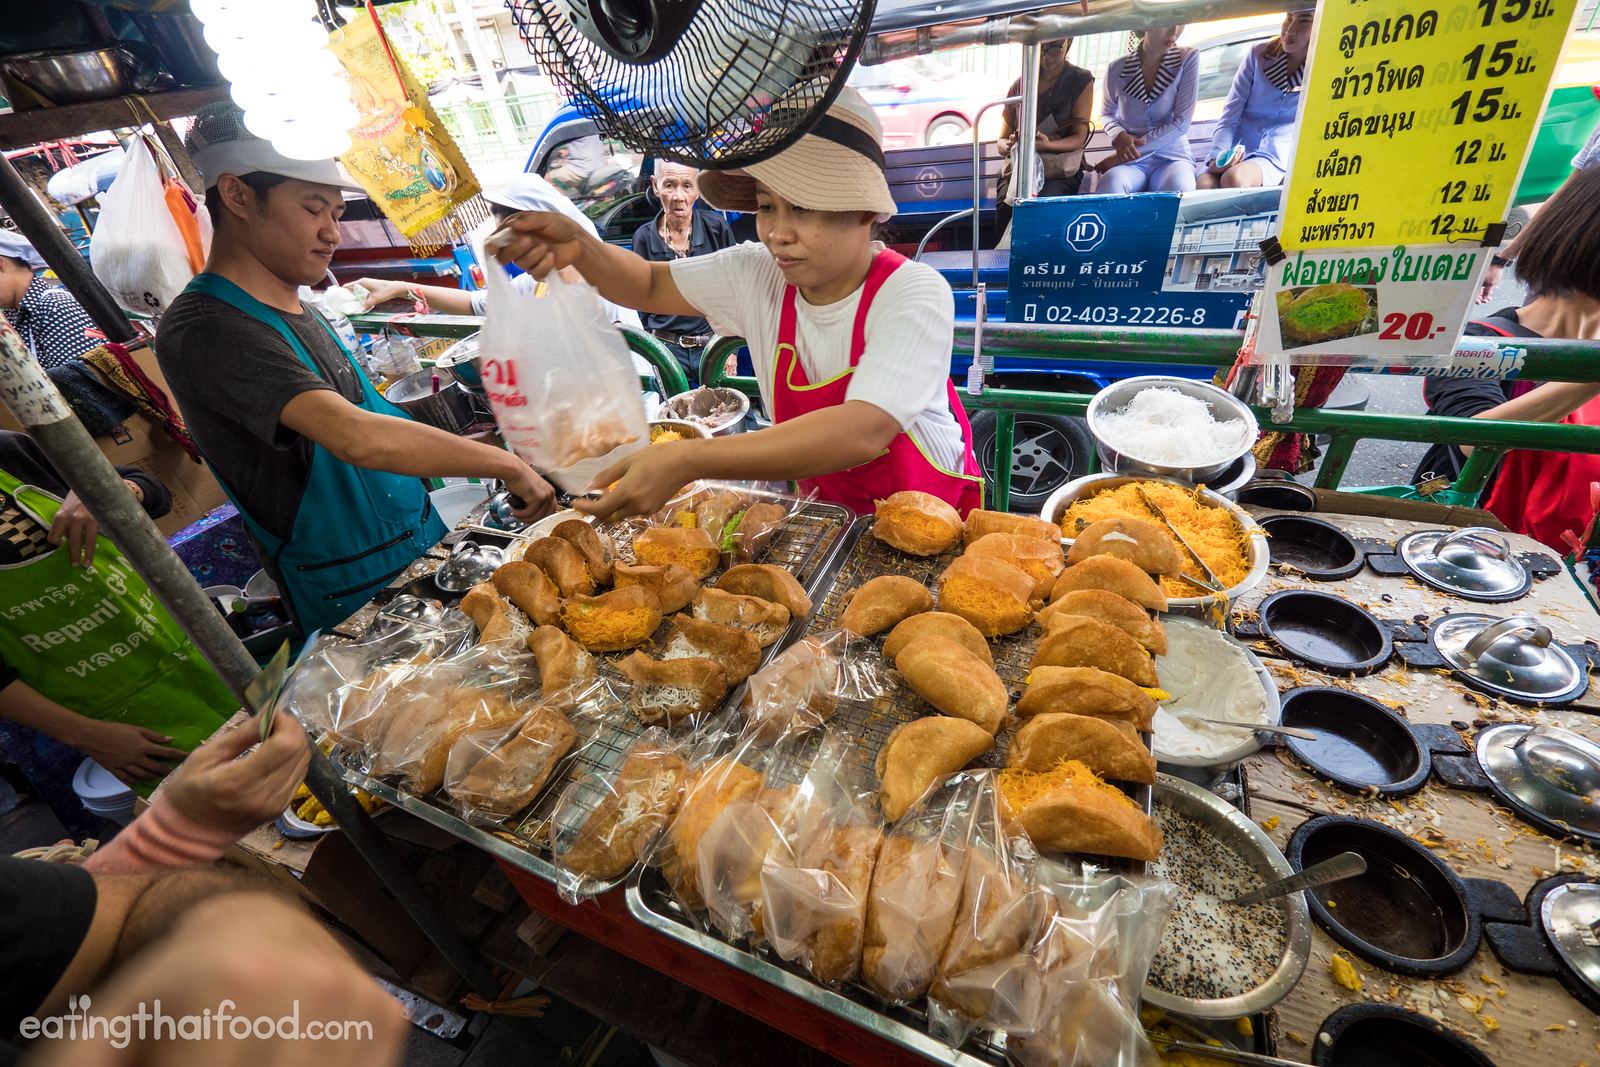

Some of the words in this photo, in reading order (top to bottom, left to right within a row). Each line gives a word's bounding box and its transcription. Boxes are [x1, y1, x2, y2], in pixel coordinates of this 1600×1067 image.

[1339, 10, 1438, 59] ลูกเกด
[1331, 60, 1424, 99] ข้าวโพด
[1323, 109, 1415, 141] เม็ดขนุน
[1316, 149, 1362, 178] เผือก
[1306, 189, 1359, 214] สังขยา
[1300, 217, 1375, 243] มะพร้าวงา
[1023, 262, 1066, 275] ดรีม
[1045, 306, 1206, 325] 02-403-2226-8
[20, 597, 121, 653] Reparil
